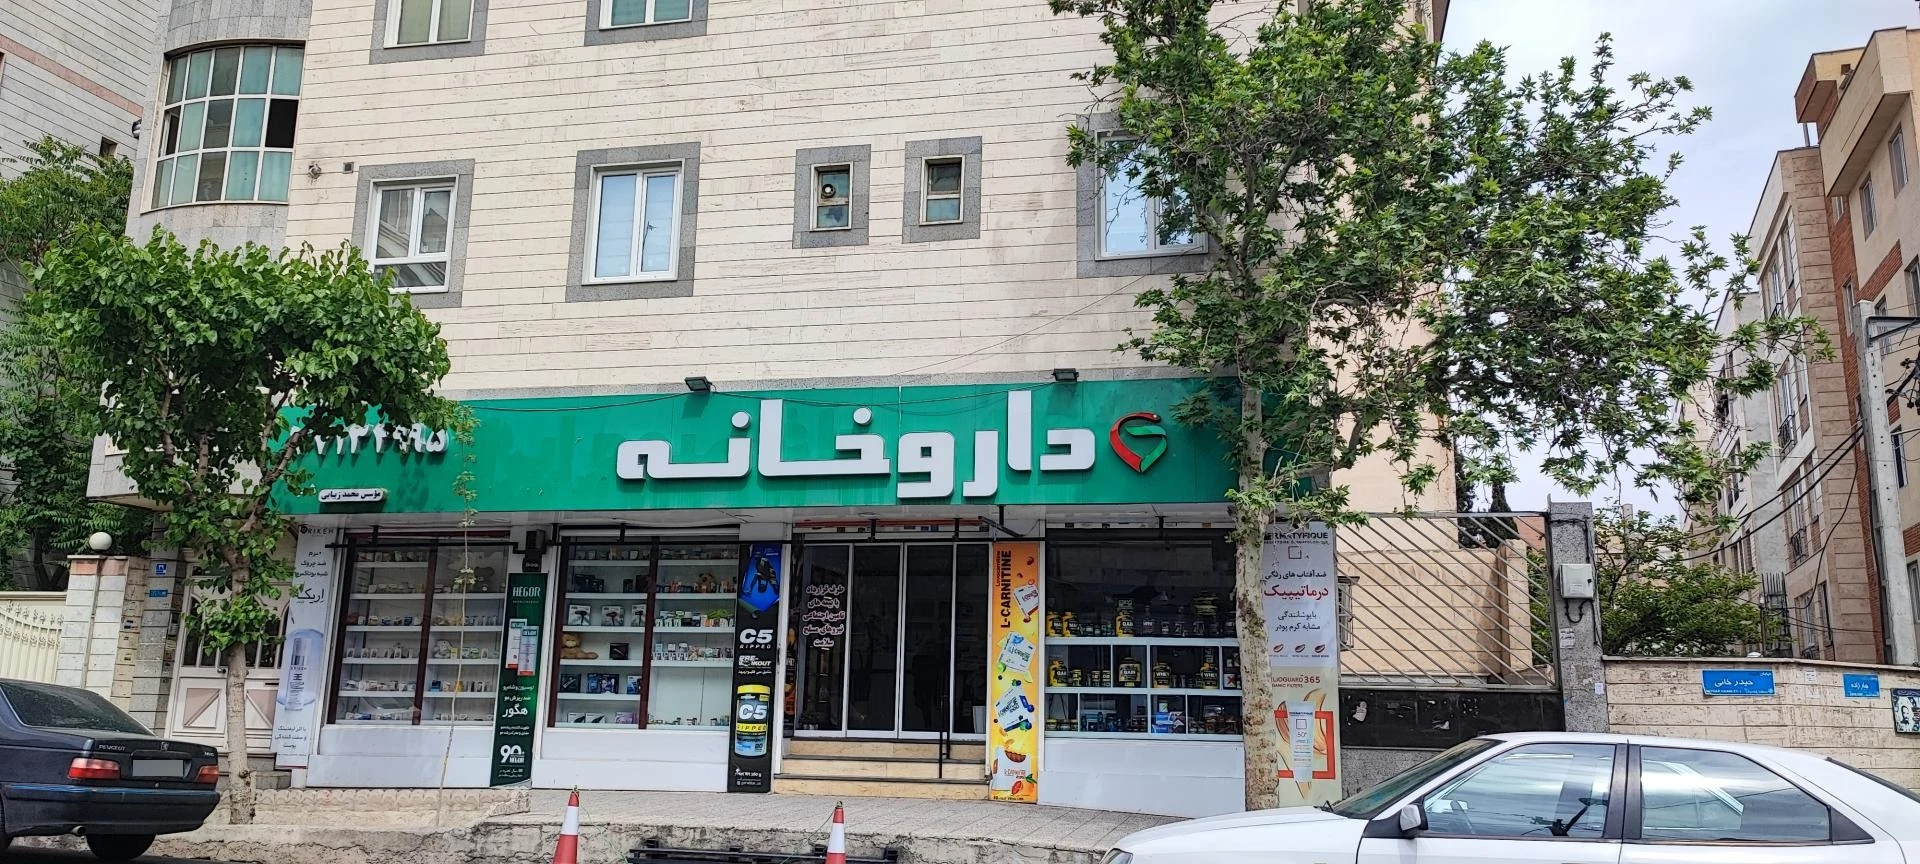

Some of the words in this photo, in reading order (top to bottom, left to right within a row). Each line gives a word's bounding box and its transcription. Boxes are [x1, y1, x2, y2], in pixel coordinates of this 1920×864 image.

[617, 390, 1096, 498] داروخانه
[301, 525, 334, 534] RIKEH
[1283, 571, 1296, 579] های
[1297, 570, 1315, 579] آفتاب
[297, 588, 325, 604] اریک
[512, 586, 540, 597] HEGOR
[1001, 550, 1012, 628] L-CARNITINE
[1264, 584, 1329, 600] درماتیپیک
[740, 628, 773, 644] C5
[1734, 678, 1753, 687] حیدر
[502, 703, 528, 718] هگور
[739, 704, 768, 719] C5
